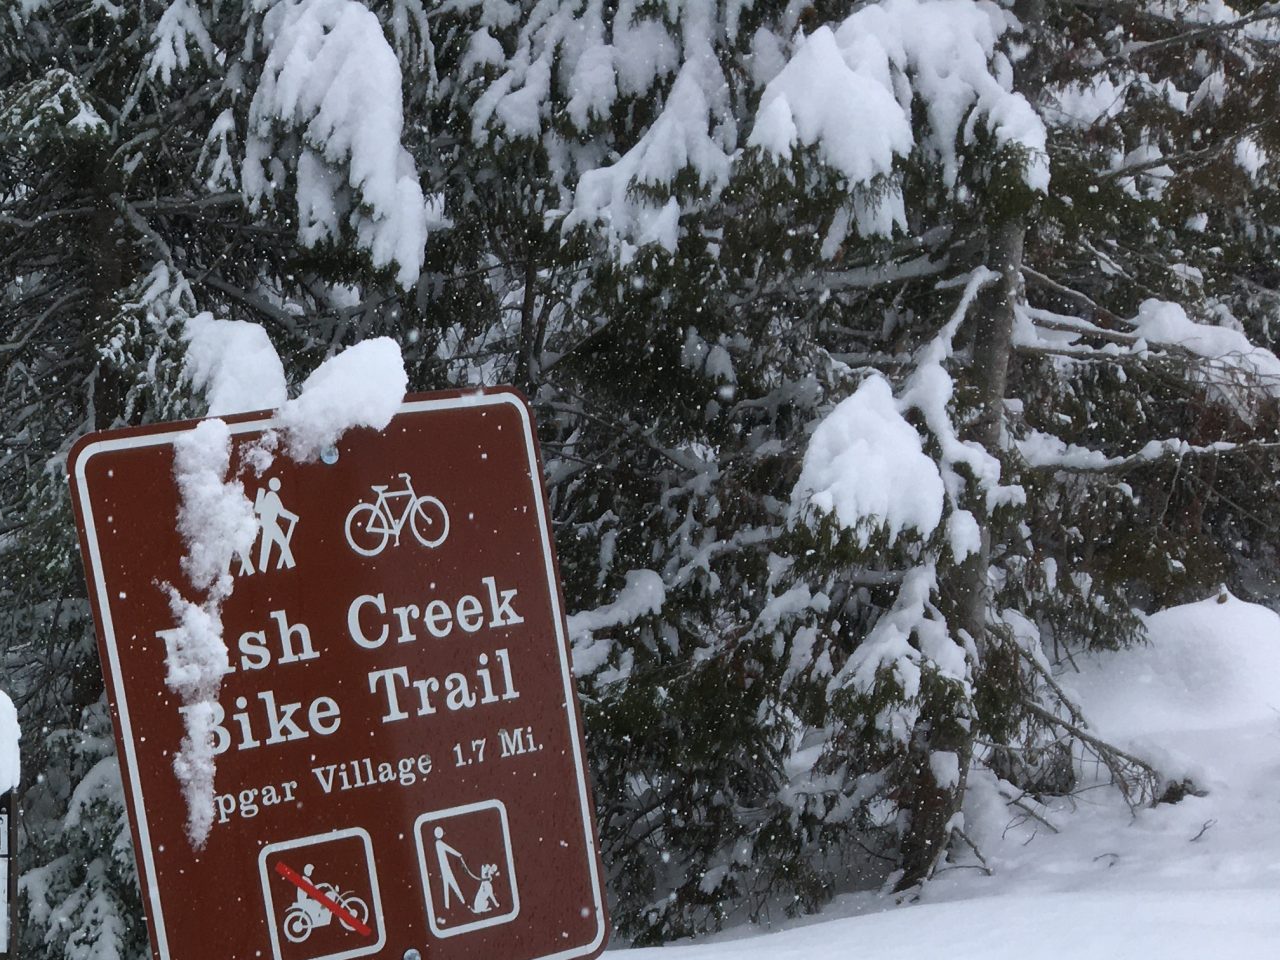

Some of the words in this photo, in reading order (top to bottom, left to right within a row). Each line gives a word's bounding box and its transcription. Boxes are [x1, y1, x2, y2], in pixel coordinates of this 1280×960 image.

[156, 610, 321, 684] sh
[348, 576, 525, 649] Creek
[368, 648, 520, 724] Trail
[214, 780, 298, 823] pgar
[312, 754, 433, 794] Village
[453, 737, 487, 768] 1.7
[498, 727, 545, 759] Mi.
